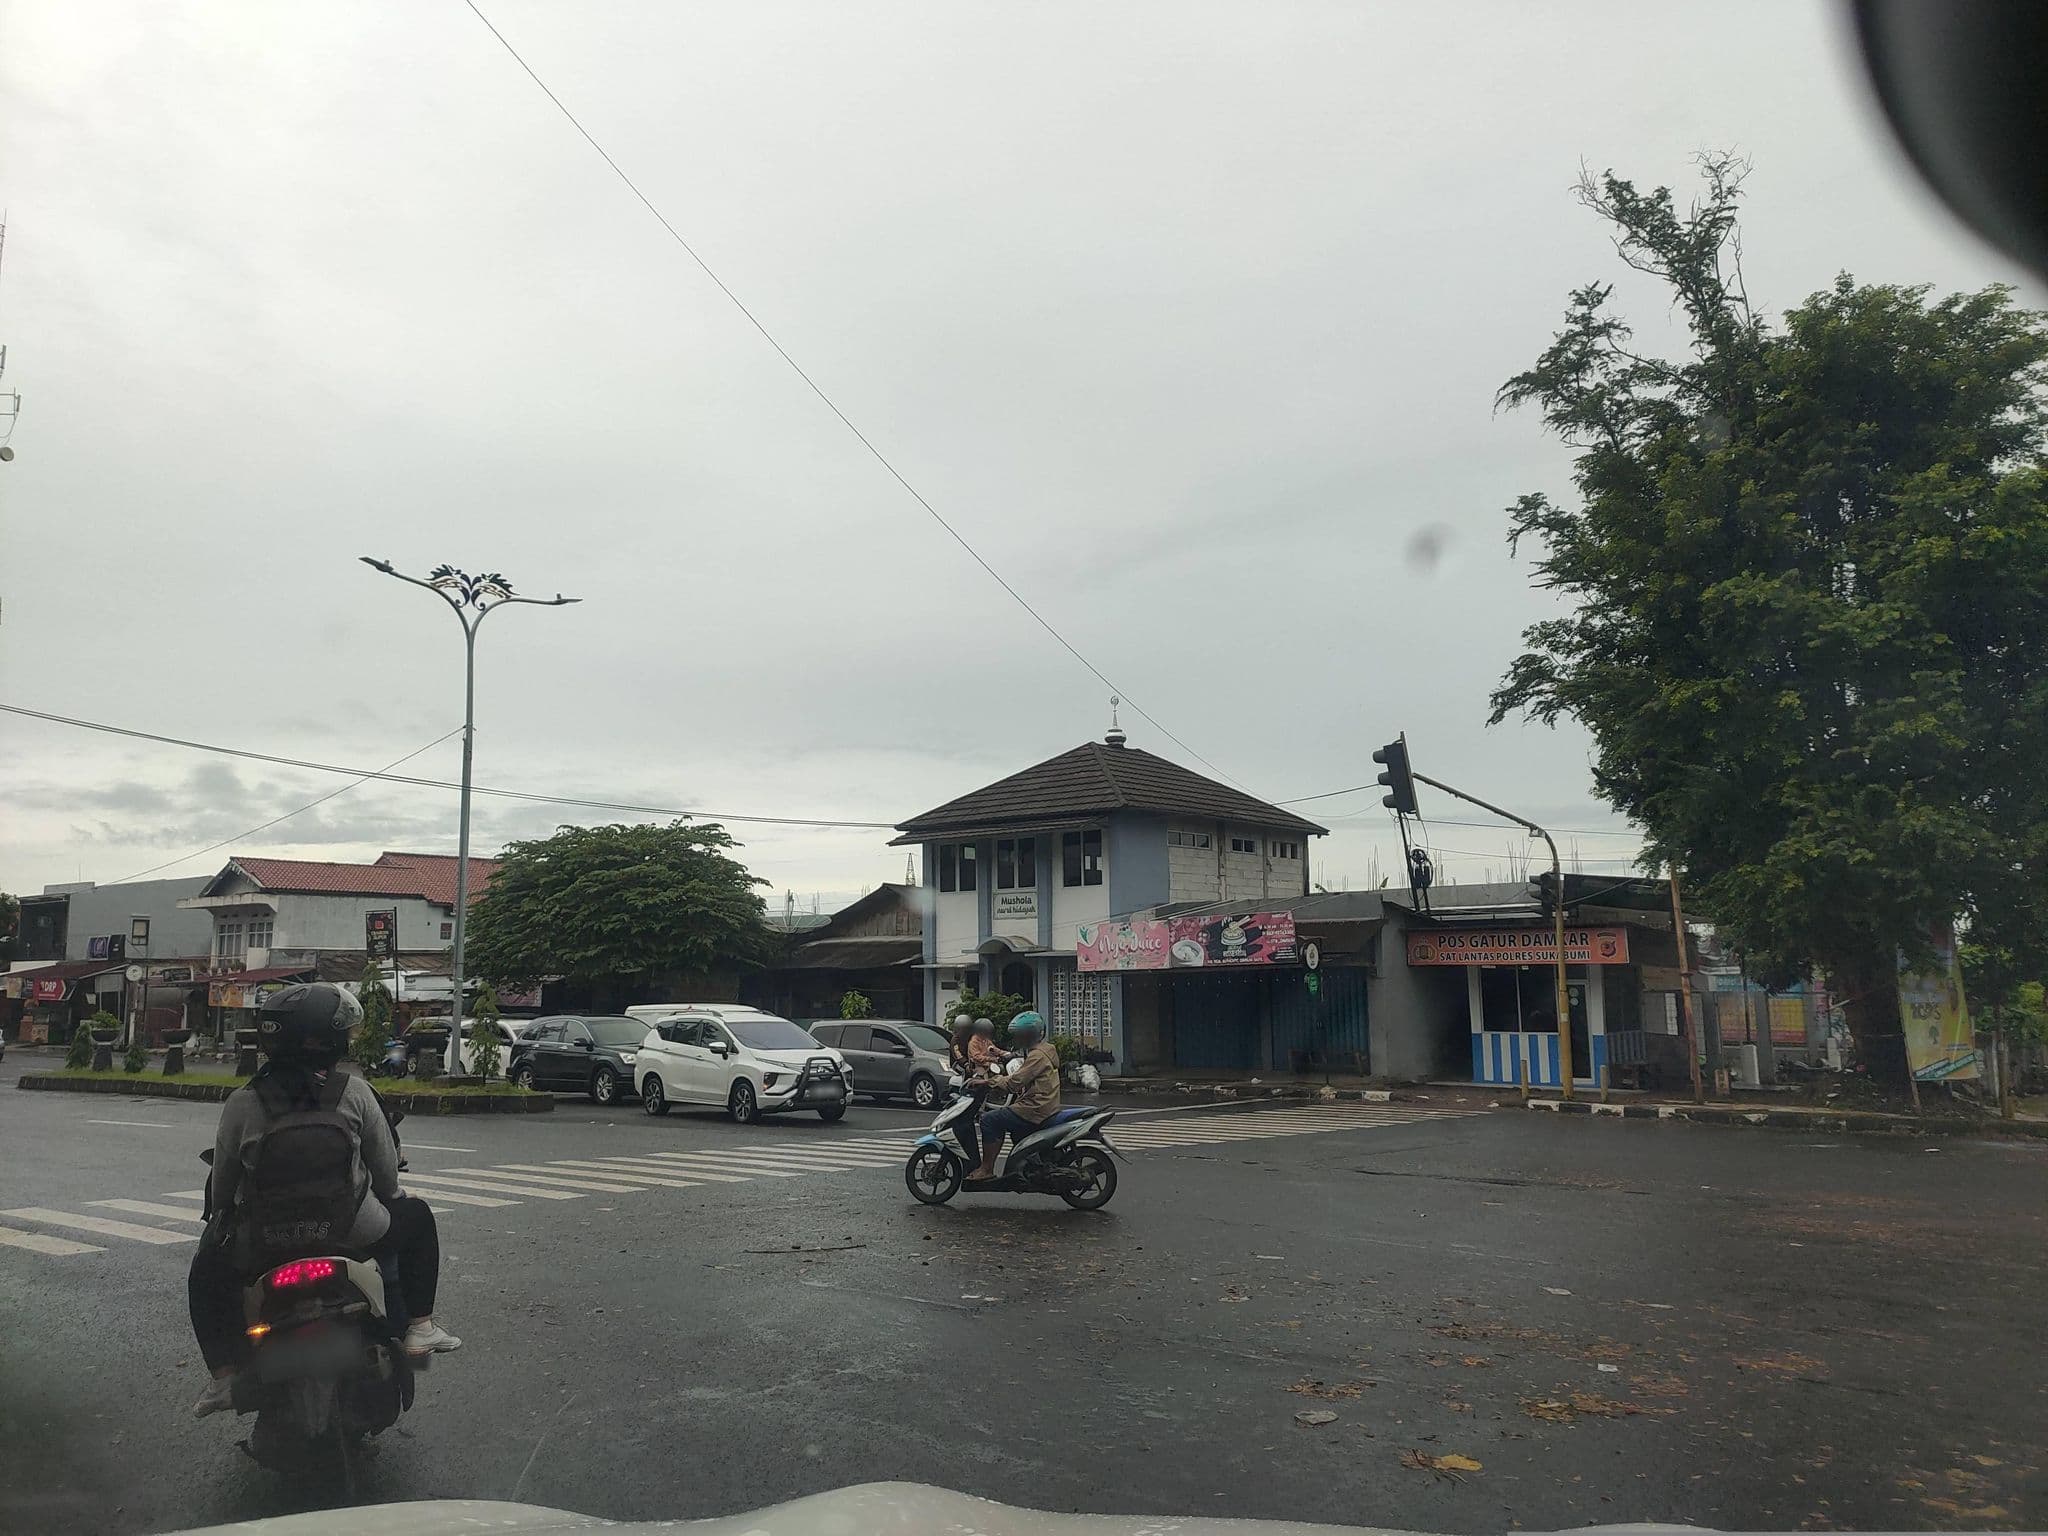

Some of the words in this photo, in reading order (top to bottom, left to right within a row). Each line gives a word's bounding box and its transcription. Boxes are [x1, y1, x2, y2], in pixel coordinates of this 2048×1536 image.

[1001, 896, 1033, 905] Mushola
[1439, 935, 1466, 949] POS
[1469, 934, 1517, 948] GATUR
[1440, 952, 1458, 961] SAT
[1459, 952, 1495, 961] LANTAS
[1496, 951, 1533, 961] POLRES
